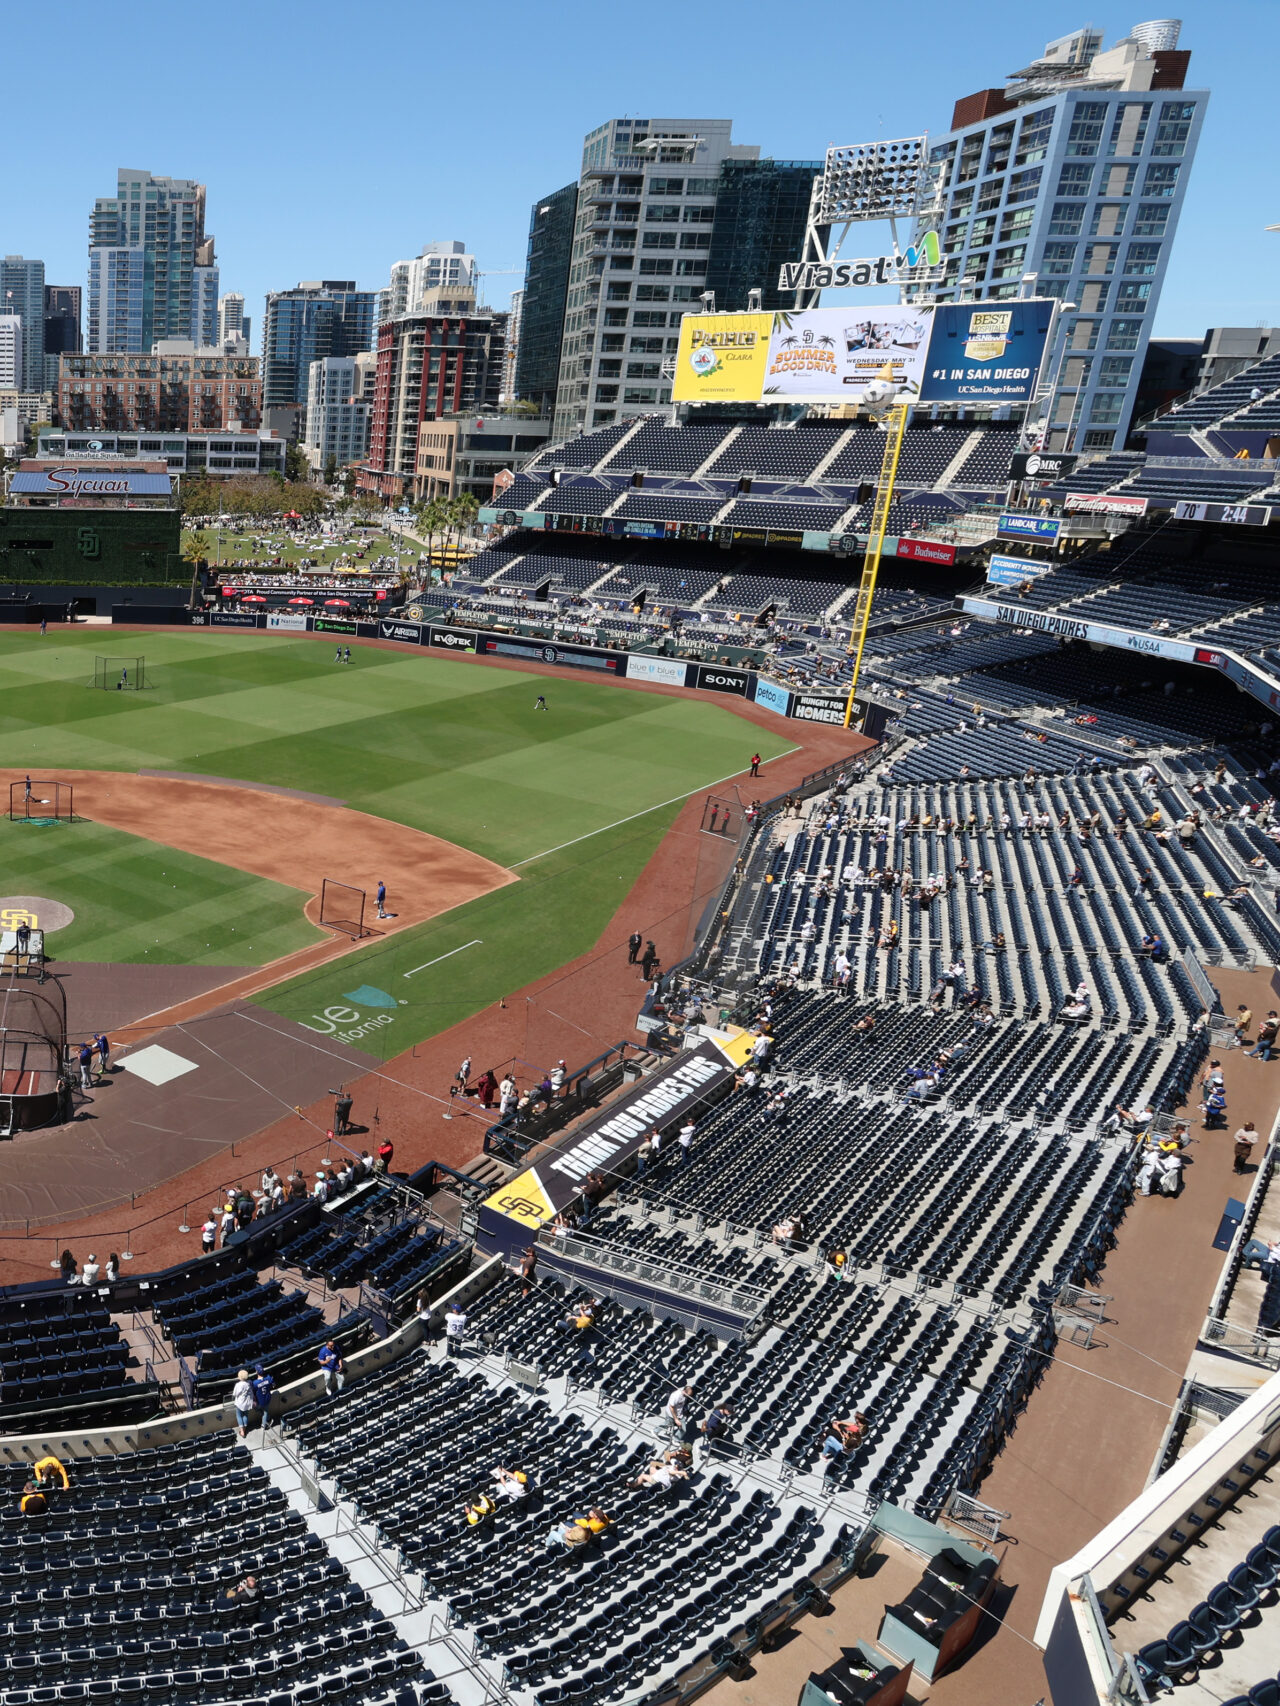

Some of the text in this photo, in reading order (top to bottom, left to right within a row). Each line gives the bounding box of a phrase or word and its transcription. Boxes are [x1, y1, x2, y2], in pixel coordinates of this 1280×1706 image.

[785, 257, 888, 289] Viasat
[973, 313, 1009, 325] BEST
[971, 325, 1007, 333] HOSPITALS
[774, 348, 836, 365] SUMMER
[769, 361, 812, 375] BLOOD
[812, 360, 838, 375] DRIVE
[932, 367, 1030, 380] #1 IN SAN DIEGO
[982, 386, 1002, 394] Diego
[1002, 385, 1025, 393] Health
[65, 451, 125, 460] Gallagher Square
[1040, 459, 1062, 471] MRC
[46, 467, 132, 499] Sycuan
[1107, 502, 1144, 515] SAUSAGES
[1220, 506, 1247, 523] 2:44
[1007, 517, 1037, 531] LANDCARE
[914, 545, 952, 562] Budweiser
[191, 616, 205, 625] 396
[280, 618, 304, 626] National
[454, 609, 489, 621] TEMPLETON
[497, 616, 519, 625] OFFICIAL
[519, 619, 543, 628] WHISKEY
[564, 624, 578, 632] DIEGO
[578, 626, 597, 635] PADRES
[996, 606, 1089, 640] SAN DIEGO PADRES
[393, 627, 406, 635] AIR
[604, 630, 647, 642] TEMPLETON
[434, 633, 472, 647] EVOTEK
[673, 639, 720, 653] TEMPLETON
[1138, 639, 1161, 653] USAA
[629, 662, 647, 672] blue
[656, 666, 676, 676] blue
[705, 673, 745, 689] SONY
[756, 687, 777, 704] petco
[800, 696, 829, 709] HUNGRY
[829, 700, 844, 711] FOR
[795, 705, 846, 724] HOMERS
[549, 1055, 724, 1182] THANK YOU PADRES FANS
